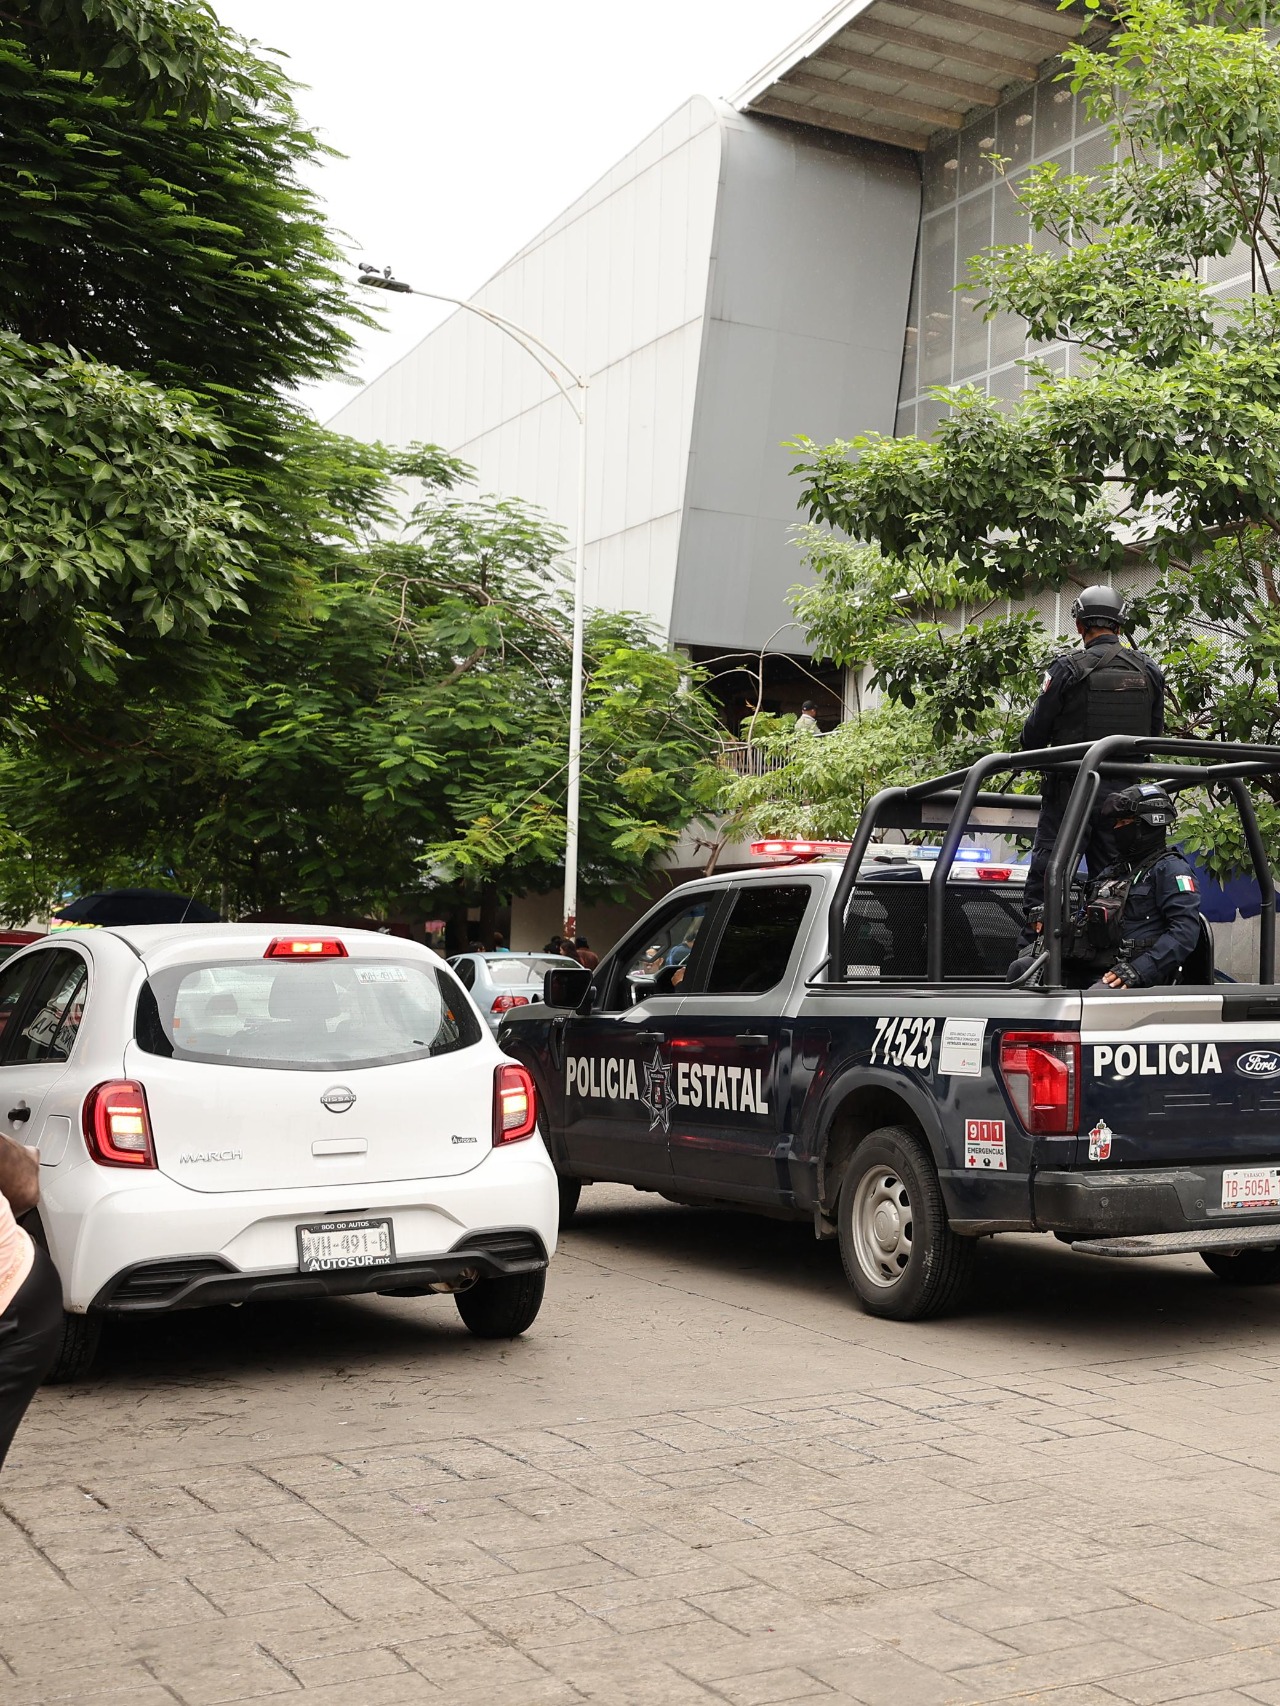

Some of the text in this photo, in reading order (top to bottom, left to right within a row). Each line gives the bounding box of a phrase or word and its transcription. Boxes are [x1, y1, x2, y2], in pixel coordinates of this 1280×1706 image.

[869, 1017, 936, 1069] 71523
[1093, 1043, 1223, 1077] POLICIA
[1245, 1052, 1277, 1072] Ford
[565, 1056, 769, 1115] POLICIA ESTATAL
[969, 1124, 1000, 1139] 911
[180, 1150, 243, 1164] MARCH
[967, 1147, 1004, 1156] EMERGENCIAS
[348, 1220, 370, 1228] AUTOS
